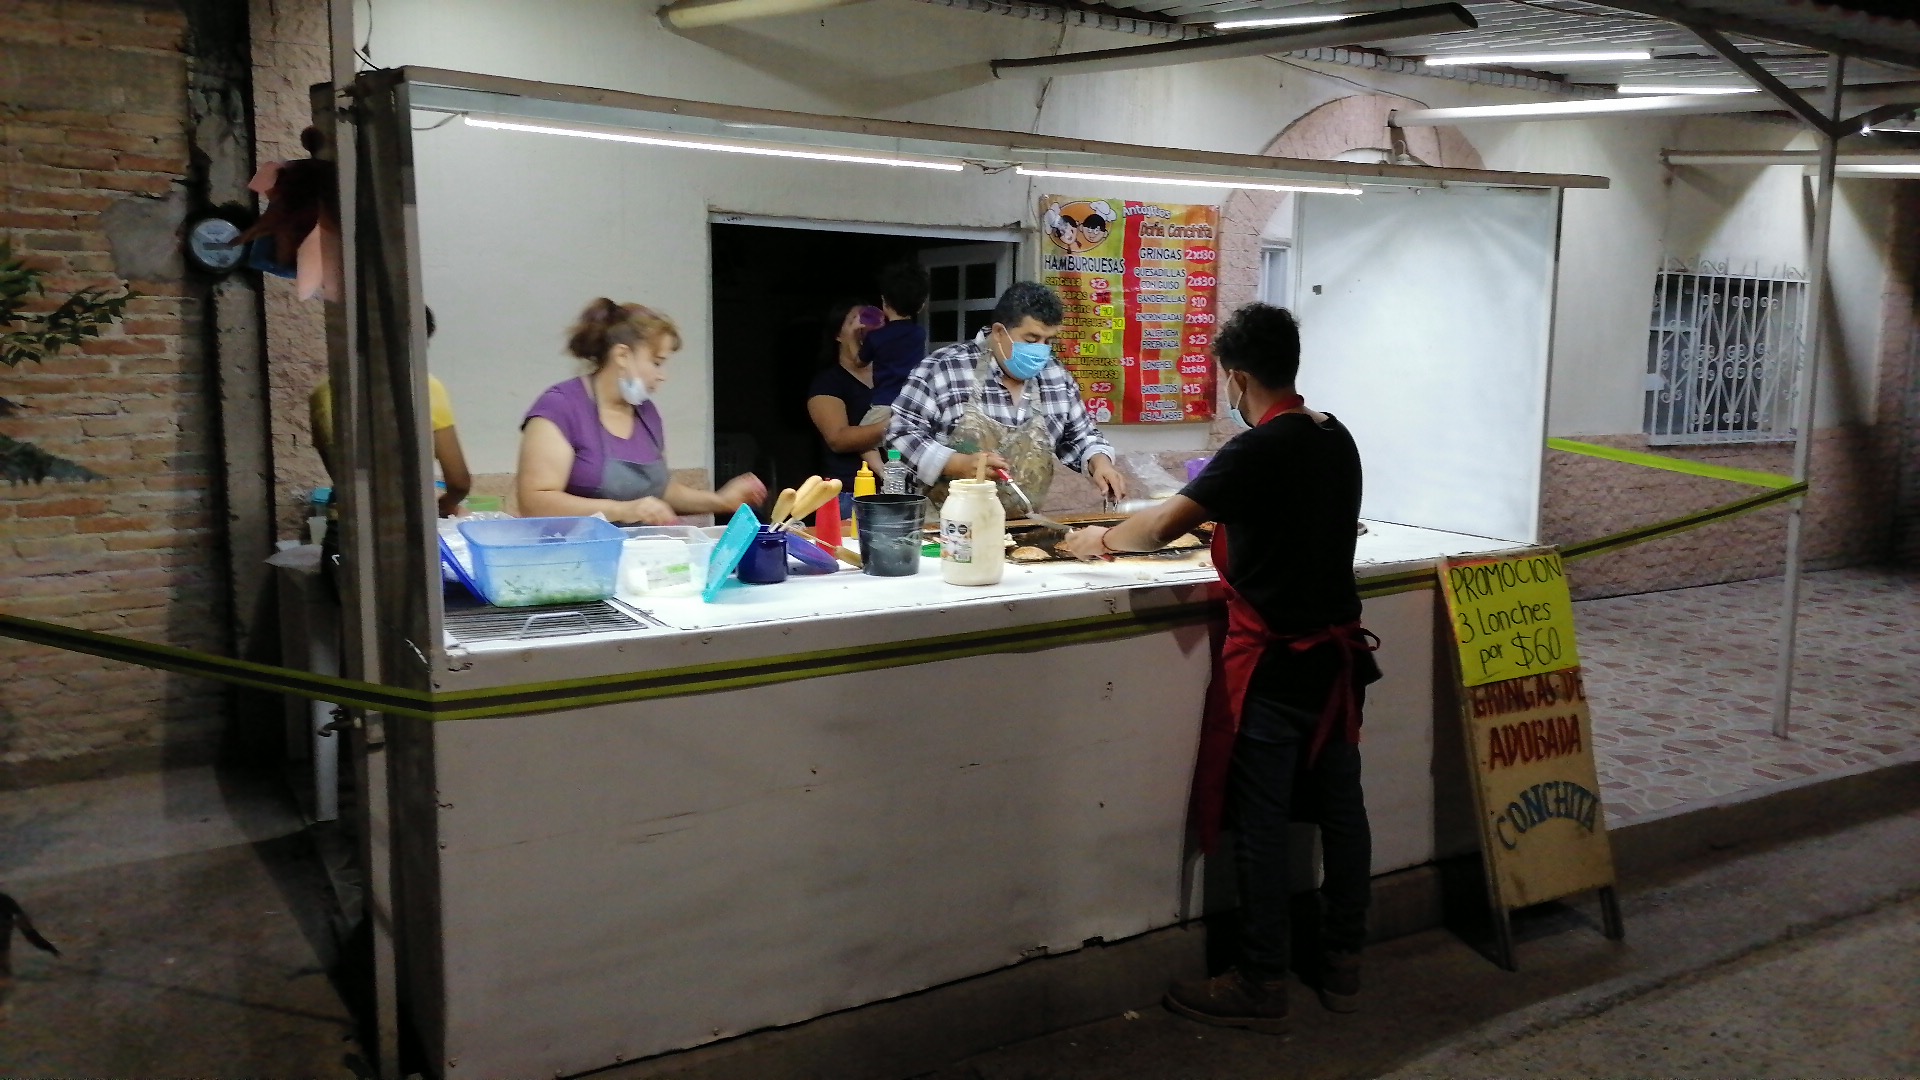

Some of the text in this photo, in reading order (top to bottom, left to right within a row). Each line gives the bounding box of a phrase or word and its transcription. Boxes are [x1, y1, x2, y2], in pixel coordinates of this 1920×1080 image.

[1140, 222, 1214, 239] Doña Conchita
[1139, 248, 1182, 261] GRINGAS
[1044, 255, 1126, 275] HAMBURGUESAS
[1134, 267, 1187, 279] QUESADILLAS
[1137, 294, 1208, 308] BANDERILLAS $10
[1187, 334, 1208, 345] $25
[1120, 357, 1135, 367] $15
[1182, 384, 1202, 395] $15
[1450, 556, 1562, 605] PROMOCION
[1457, 612, 1475, 644] 3
[1479, 626, 1562, 675] por $60
[1489, 713, 1582, 773] ADOBADA
[1496, 780, 1601, 850] CONCHITA
